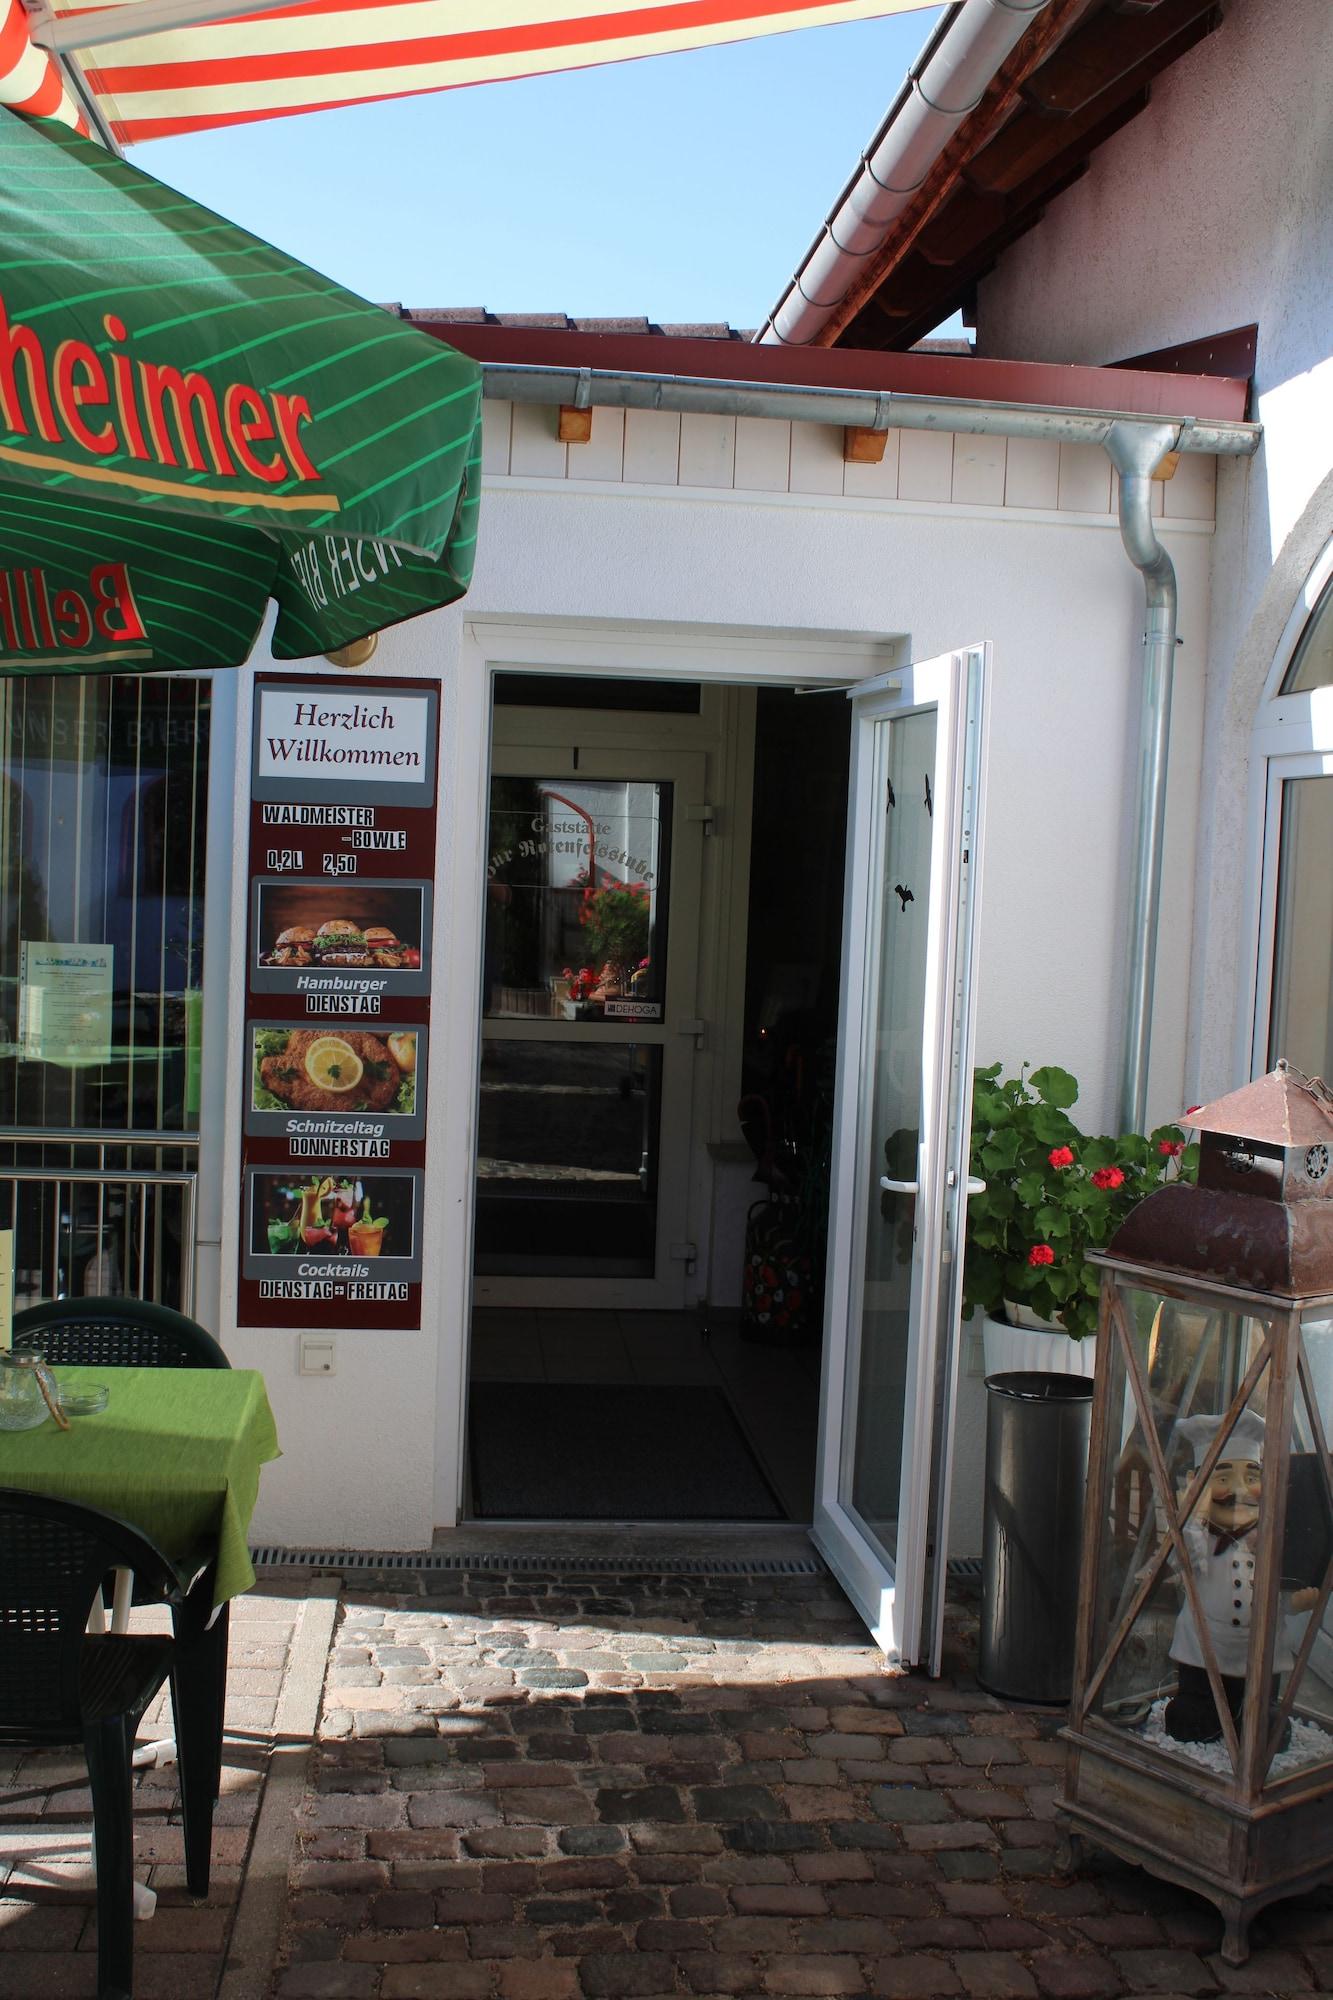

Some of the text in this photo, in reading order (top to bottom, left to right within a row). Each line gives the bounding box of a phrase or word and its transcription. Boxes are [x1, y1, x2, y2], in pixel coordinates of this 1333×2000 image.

[293, 703, 395, 730] Herzlich
[266, 738, 421, 766] Willkommen
[263, 805, 374, 827] WALDMEISTER
[267, 850, 356, 876] 0,2L 2,50
[296, 976, 387, 993] Hamburger
[306, 994, 380, 1014] DIENSTAG
[616, 1003, 657, 1015] DEHOGA
[286, 1119, 384, 1137] Schnitzeltag
[290, 1137, 390, 1157] DONNERSTAG
[297, 1263, 369, 1278] Cocktails
[259, 1280, 333, 1299] DIENSTAG
[347, 1282, 408, 1300] FREITAG
